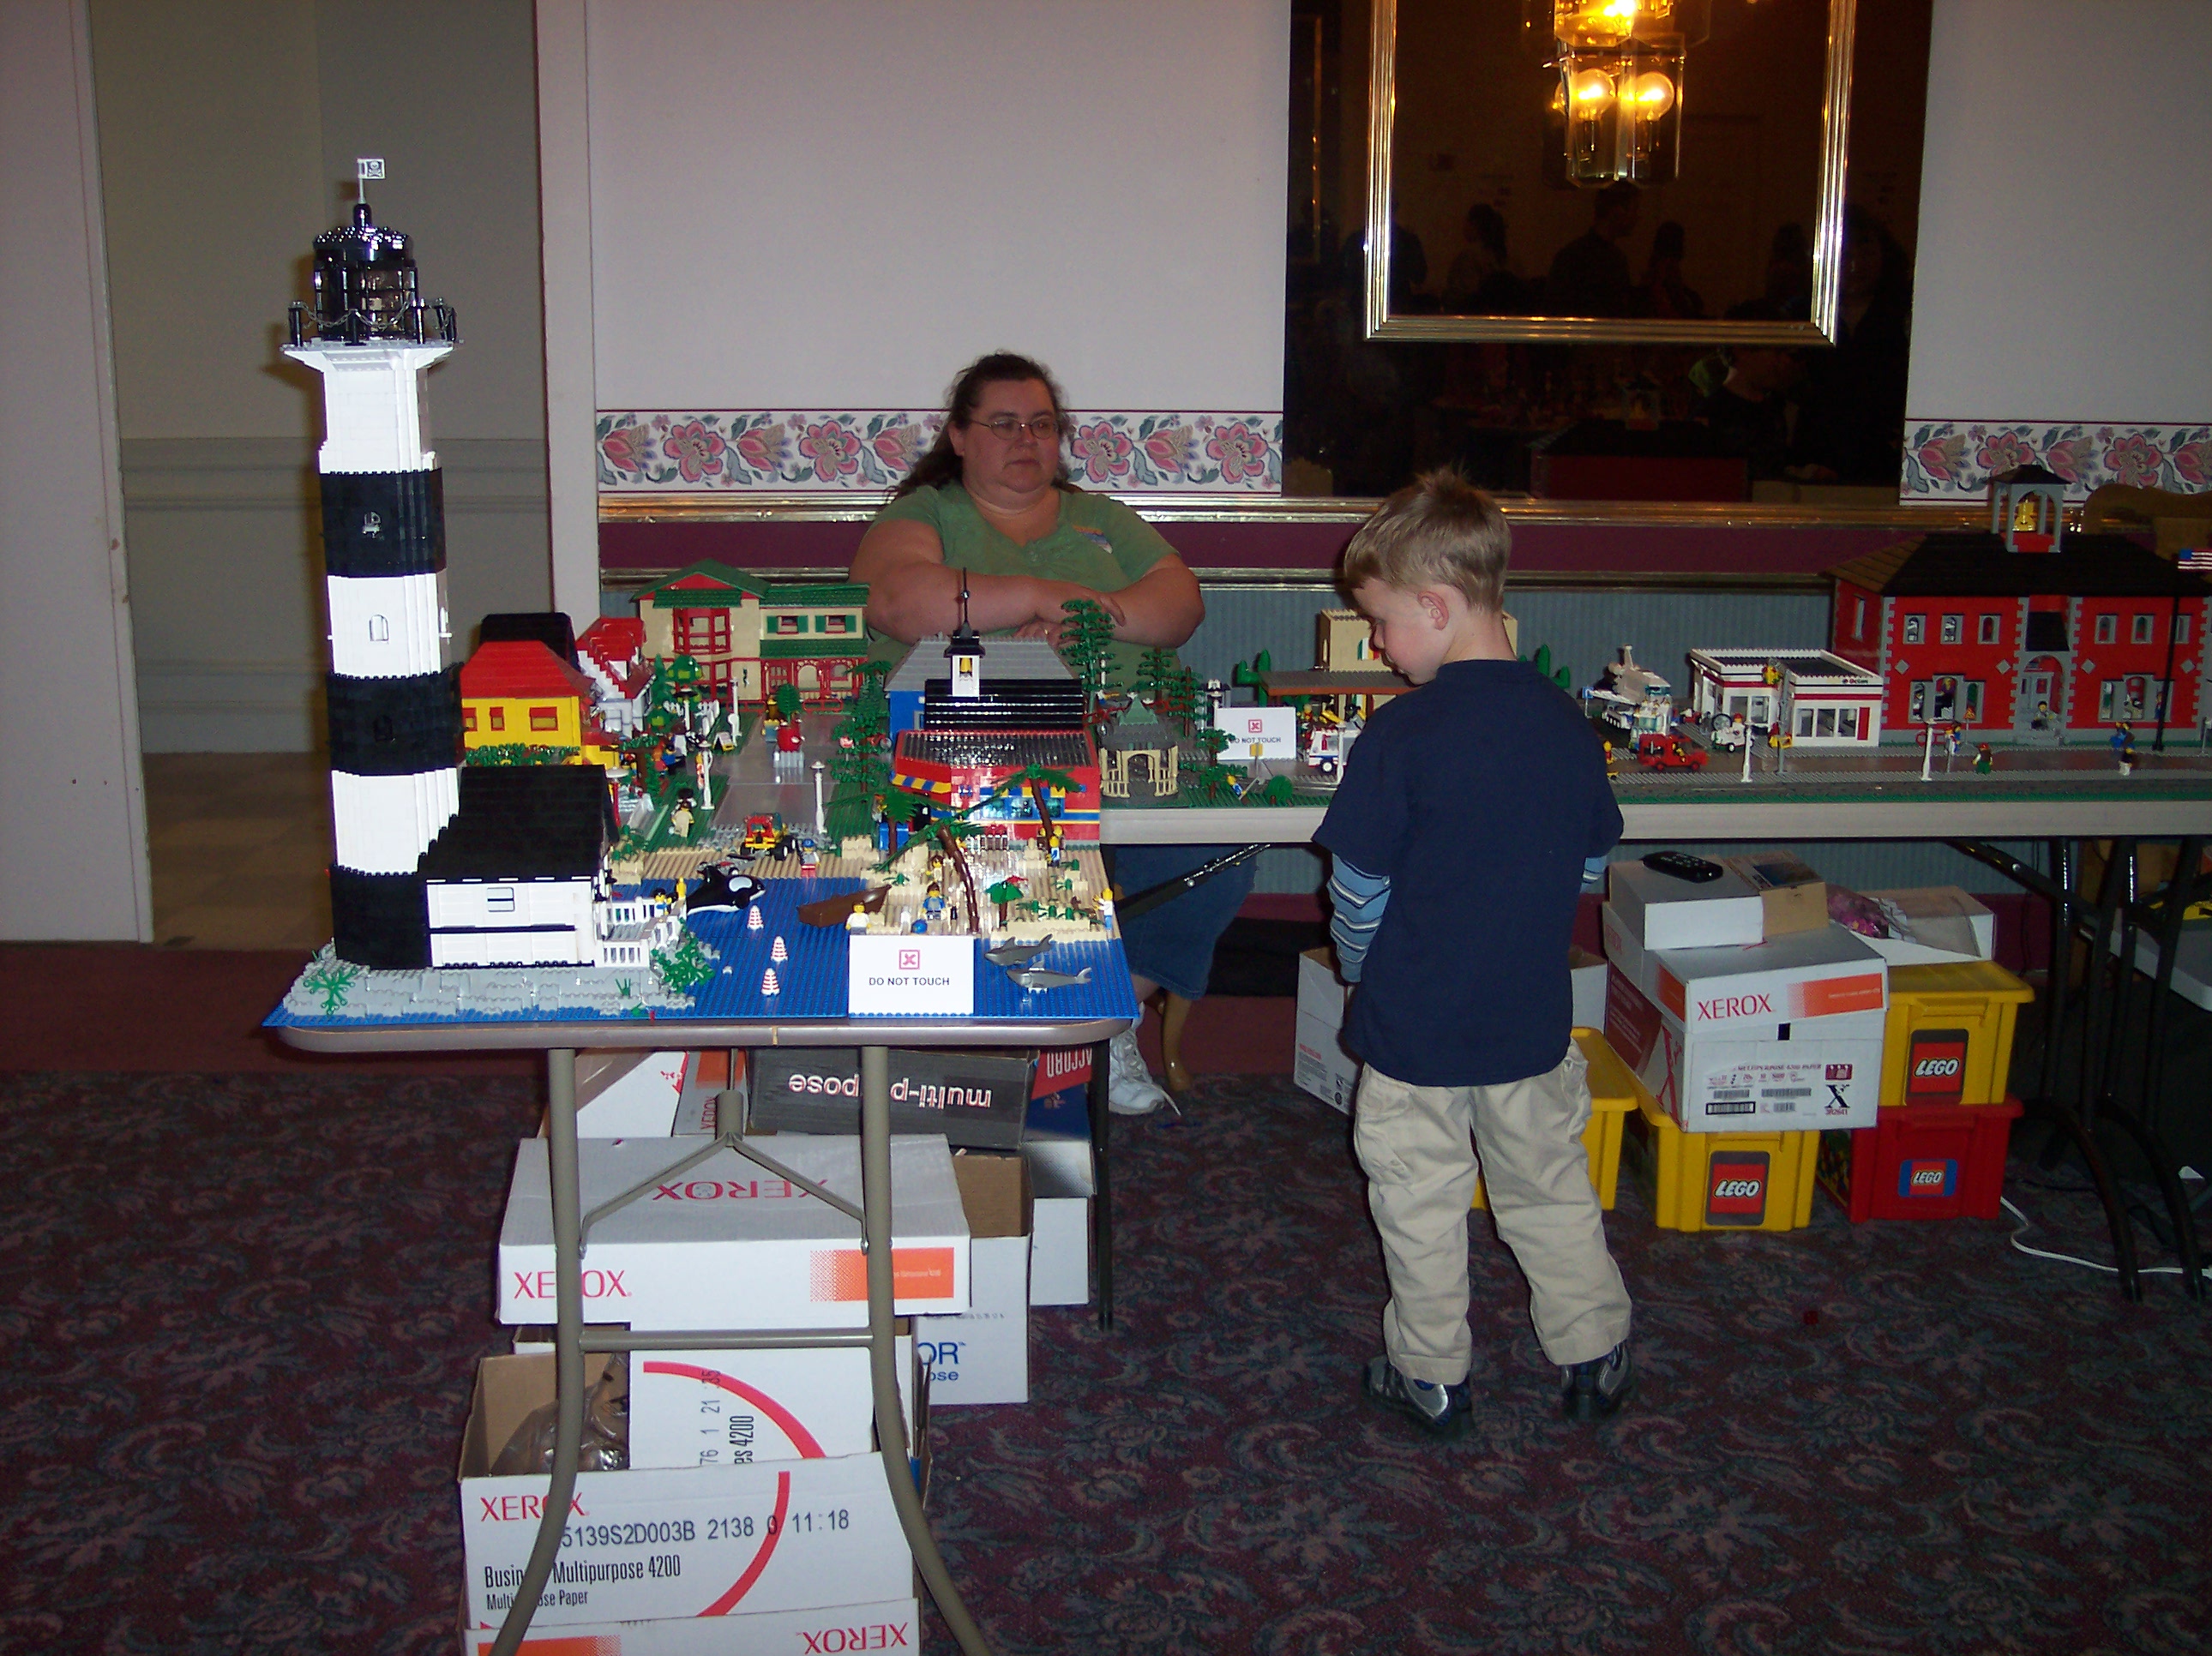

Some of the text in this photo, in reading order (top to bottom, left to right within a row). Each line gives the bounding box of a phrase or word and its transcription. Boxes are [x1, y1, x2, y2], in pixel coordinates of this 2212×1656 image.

[869, 976, 950, 986] DO NOT TOUCH
[1697, 993, 1771, 1022] XEROX
[1914, 1058, 1960, 1077] LEGO
[1714, 1179, 1762, 1198] LEGO
[1912, 1170, 1945, 1185] LEGO
[514, 1269, 628, 1299] XEOX
[729, 1415, 754, 1447] 4200
[480, 1491, 586, 1522] XERX
[707, 1516, 754, 1540] 2138
[766, 1514, 778, 1536] 0
[792, 1509, 850, 1534] 11:18
[553, 1559, 644, 1586] Multipurpose
[648, 1554, 681, 1579] 4200
[559, 1589, 588, 1607] Paper
[802, 1621, 909, 1655] XEROX
